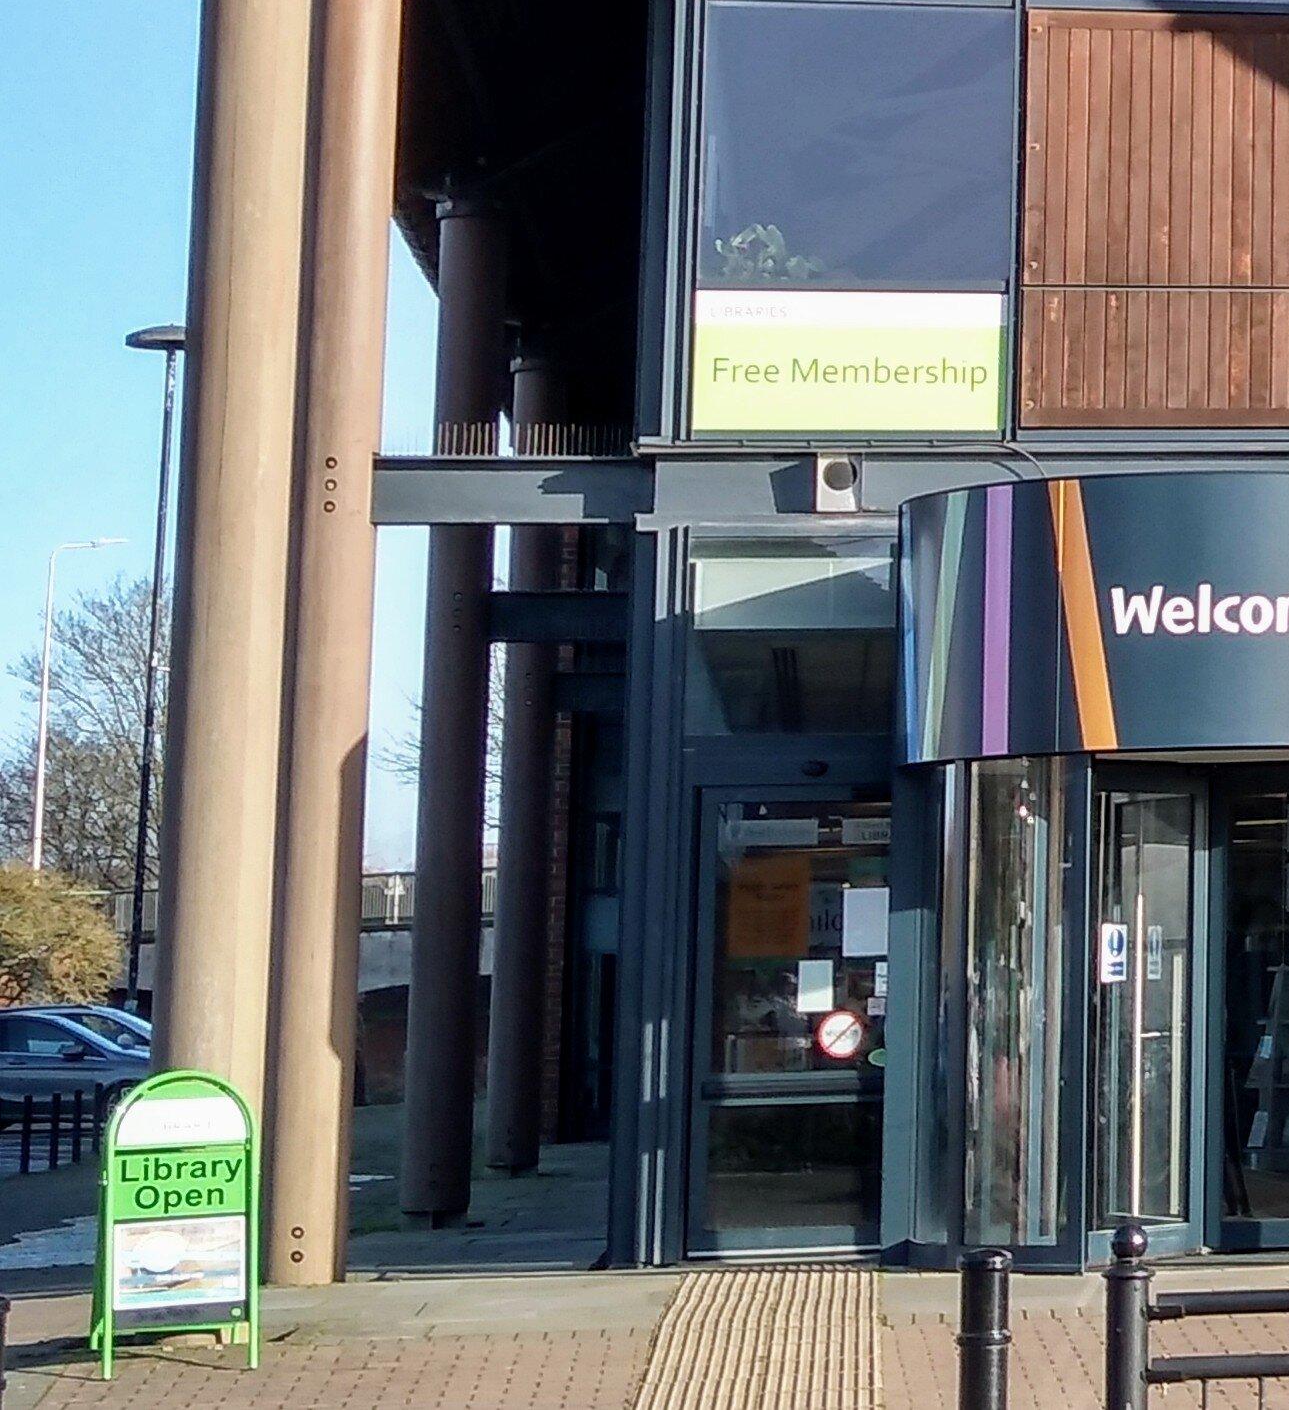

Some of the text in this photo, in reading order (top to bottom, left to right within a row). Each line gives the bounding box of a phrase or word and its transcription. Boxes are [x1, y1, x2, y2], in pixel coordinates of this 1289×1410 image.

[712, 356, 988, 392] Free Membership
[121, 1156, 243, 1183] Library
[134, 1185, 225, 1214] Open
